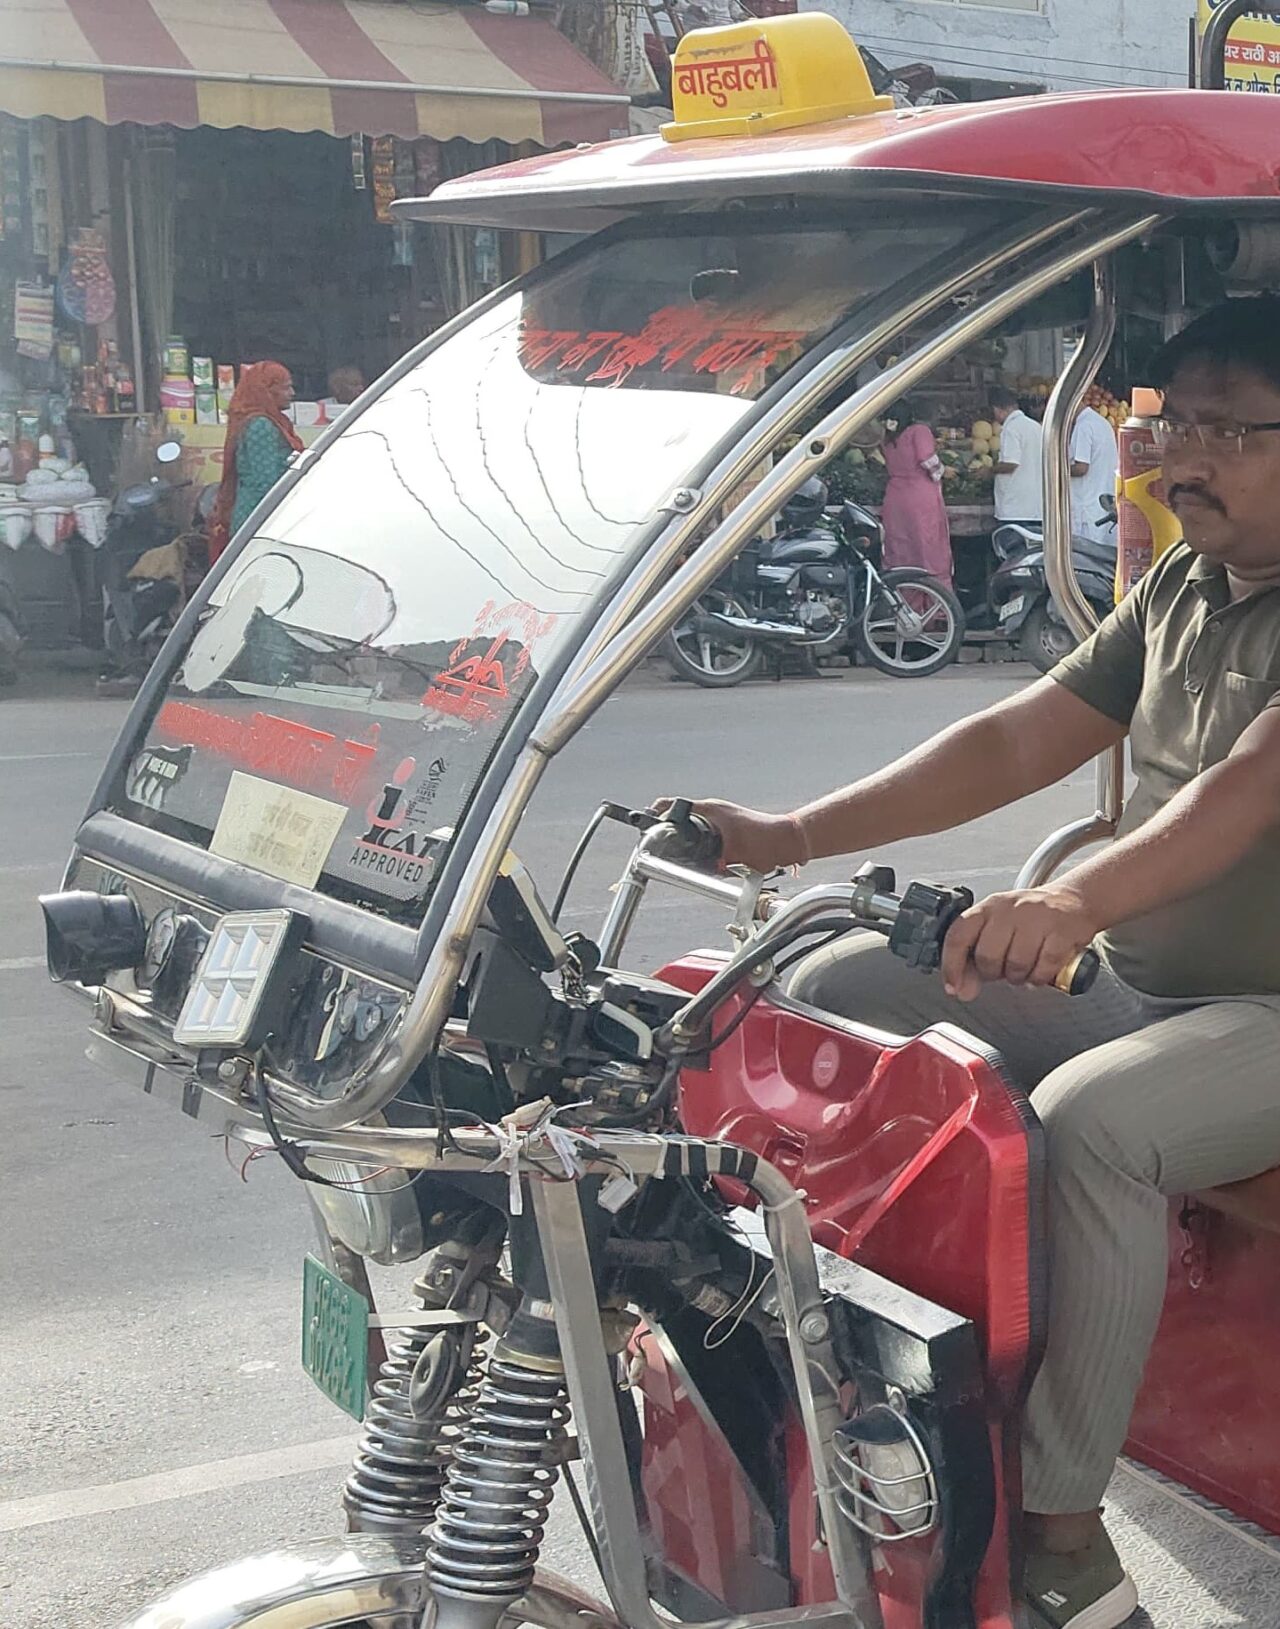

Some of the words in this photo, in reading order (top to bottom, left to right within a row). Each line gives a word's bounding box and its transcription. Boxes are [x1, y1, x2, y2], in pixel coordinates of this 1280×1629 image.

[1241, 43, 1265, 61] राठी
[675, 39, 778, 107] बाहुबली
[350, 848, 424, 883] APPROVED
